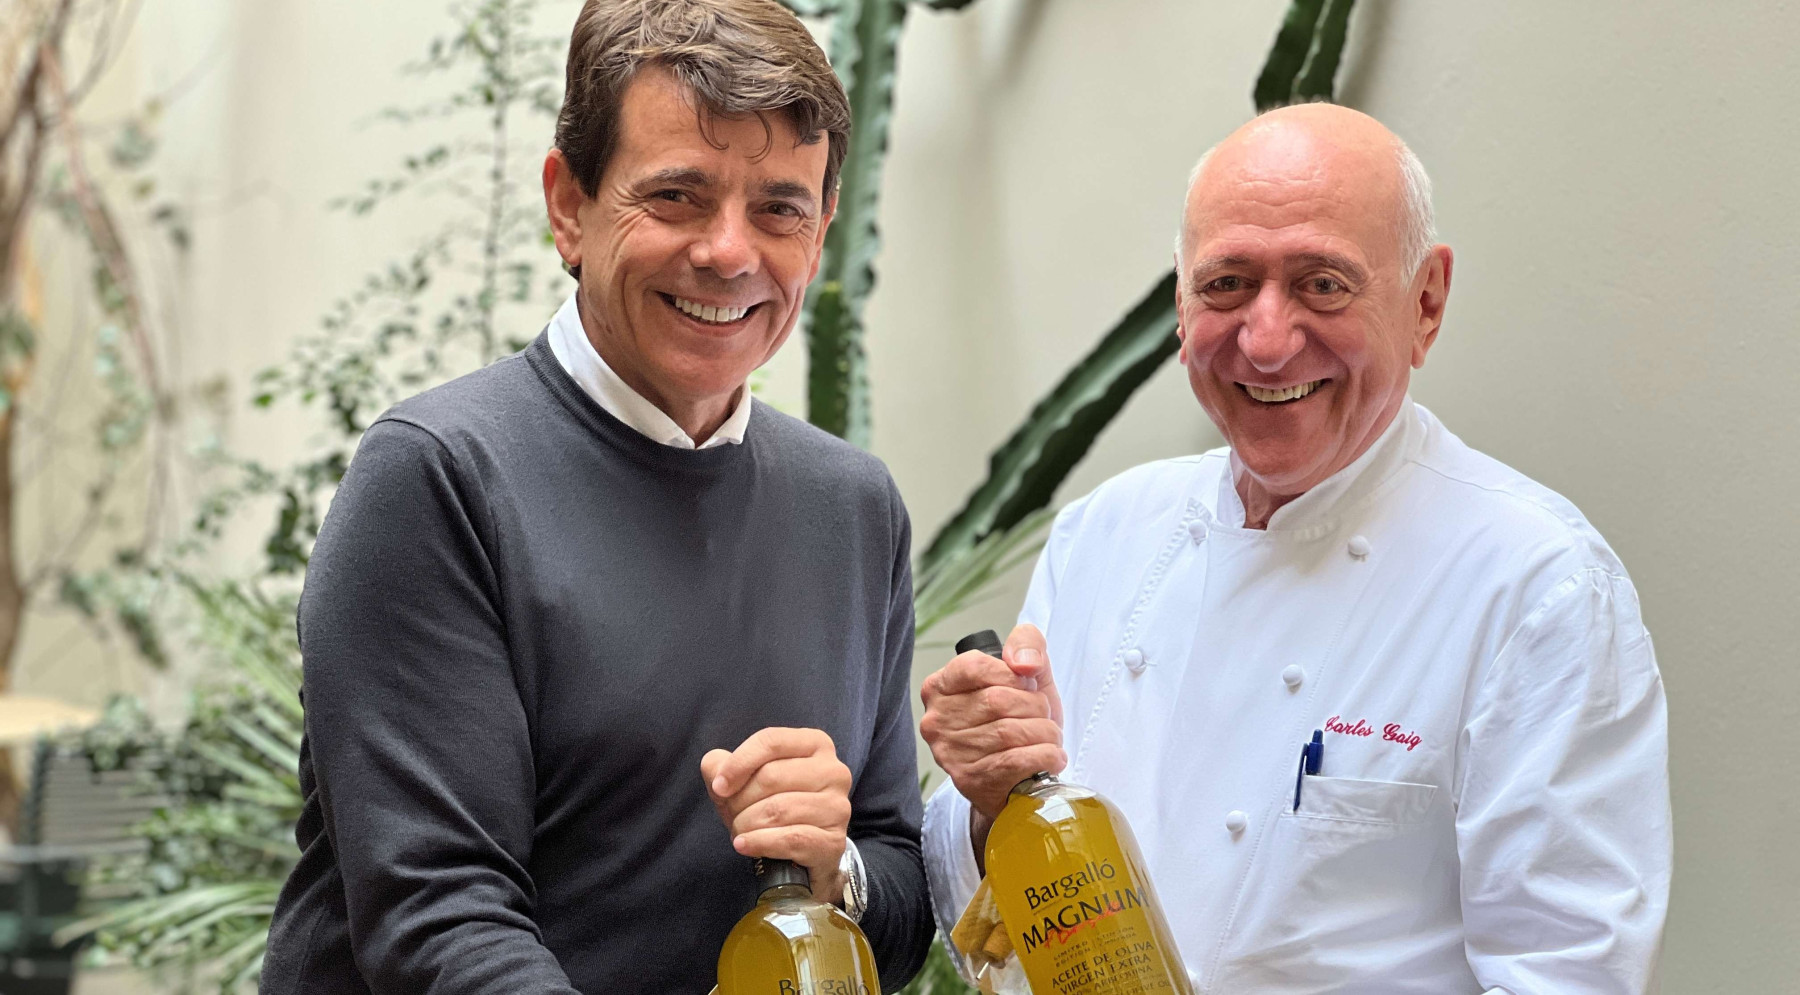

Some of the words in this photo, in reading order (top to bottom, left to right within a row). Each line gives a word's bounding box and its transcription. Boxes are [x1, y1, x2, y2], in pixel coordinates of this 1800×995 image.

[1324, 715, 1374, 737] Carles
[1382, 723, 1422, 751] Gaig
[1024, 858, 1116, 910] Bargalló
[1022, 886, 1150, 954] MAGNUM
[1052, 960, 1090, 988] ACEITE
[1093, 952, 1110, 967] DE
[1115, 940, 1155, 957] OLIVA
[1060, 968, 1106, 995] VIRGEN
[1110, 953, 1153, 973] EXTRA
